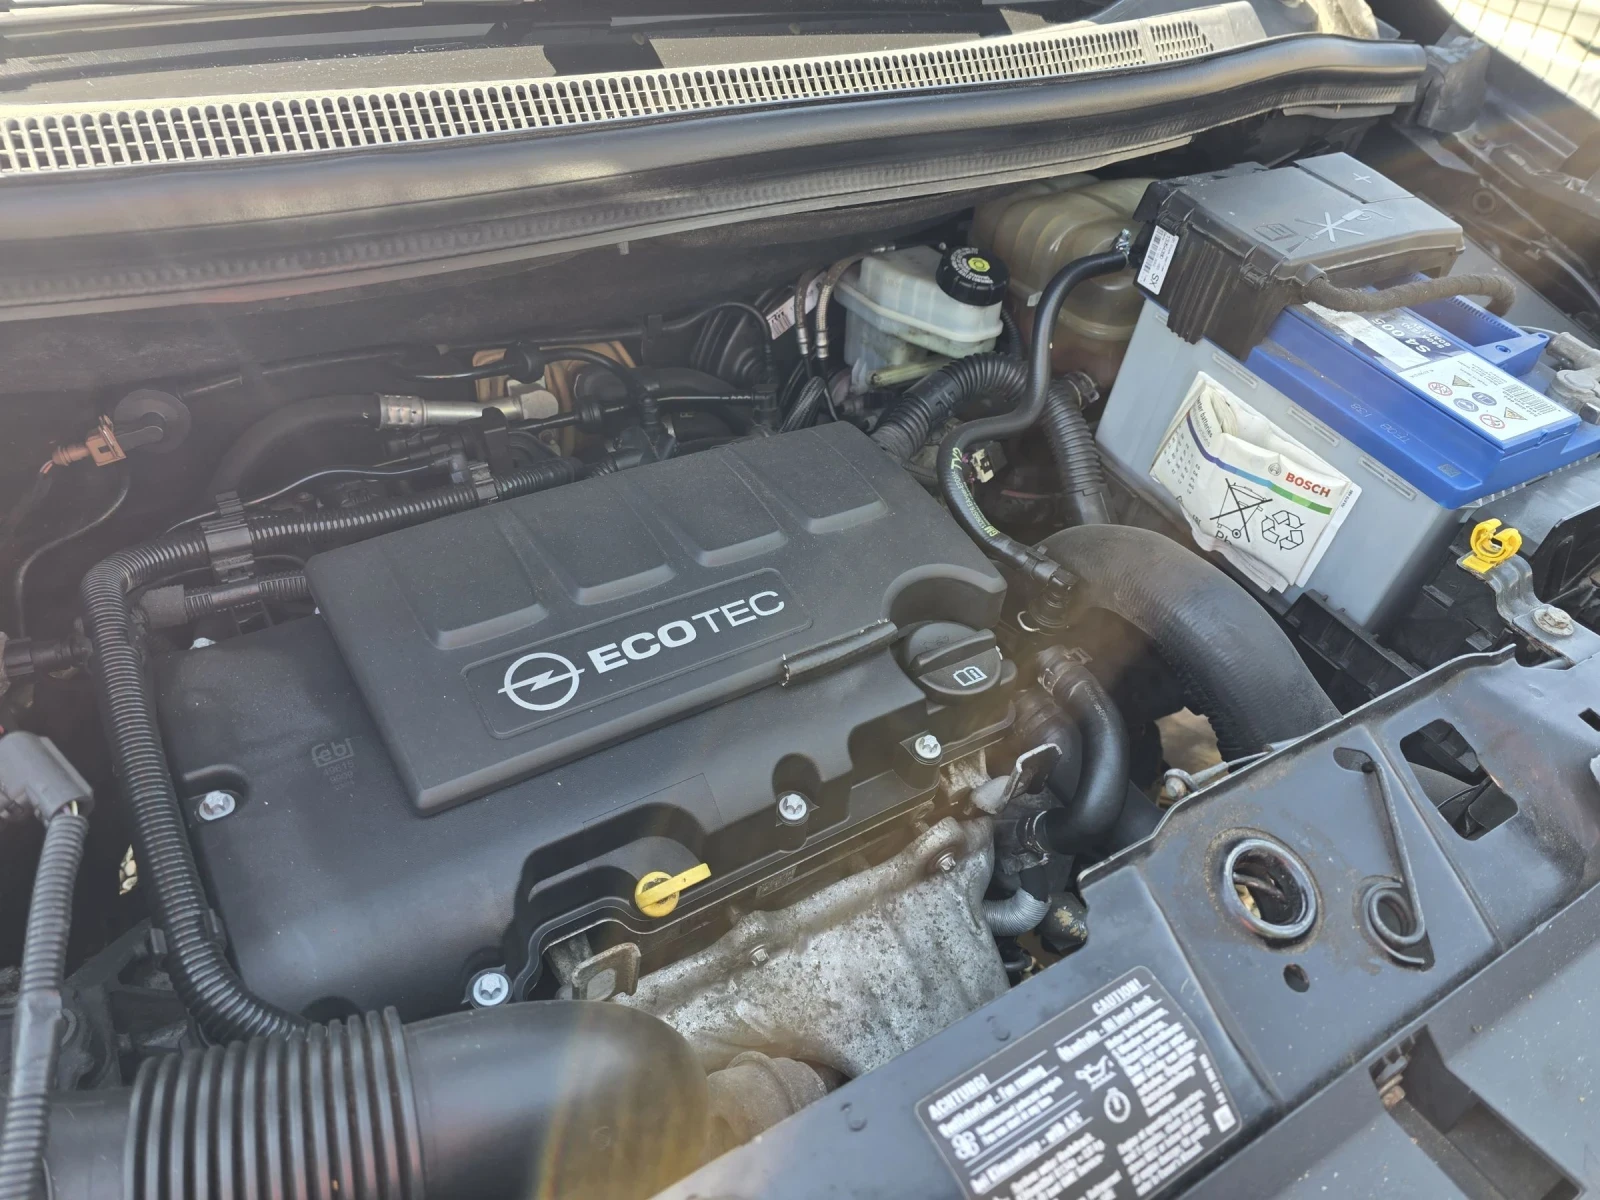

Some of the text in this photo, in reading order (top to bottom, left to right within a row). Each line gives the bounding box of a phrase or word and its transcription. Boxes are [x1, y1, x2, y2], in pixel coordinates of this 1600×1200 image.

[1372, 318, 1430, 353] S4 005
[1200, 410, 1213, 438] batteries
[1286, 472, 1331, 497] BOSCH
[587, 590, 785, 674] ECOTEC
[1092, 978, 1142, 1016] CAUTION!
[928, 1073, 990, 1120] ACHTUNG!
